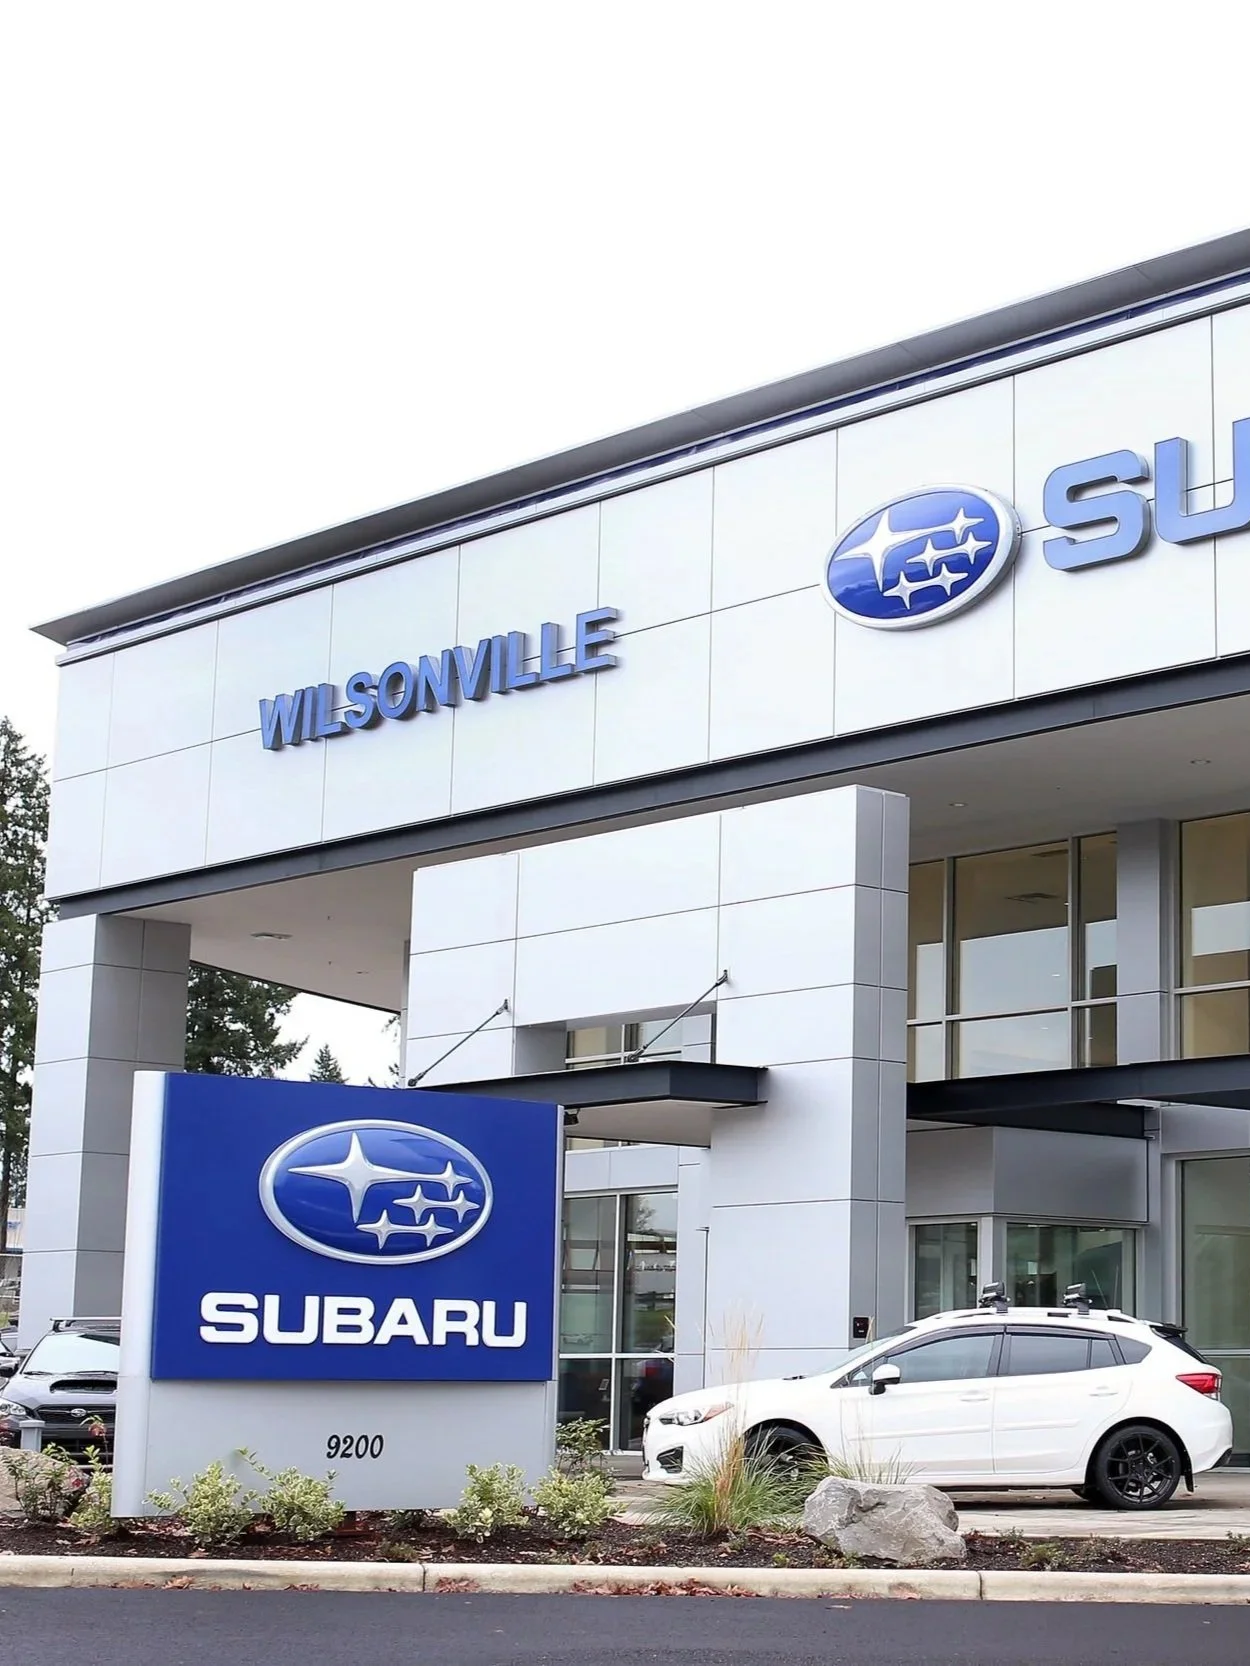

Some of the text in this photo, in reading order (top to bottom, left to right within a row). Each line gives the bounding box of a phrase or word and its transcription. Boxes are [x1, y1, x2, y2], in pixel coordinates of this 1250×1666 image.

[259, 606, 620, 751] WILSONVILLE
[199, 1291, 528, 1349] SUBARU
[326, 1434, 384, 1459] 9200
